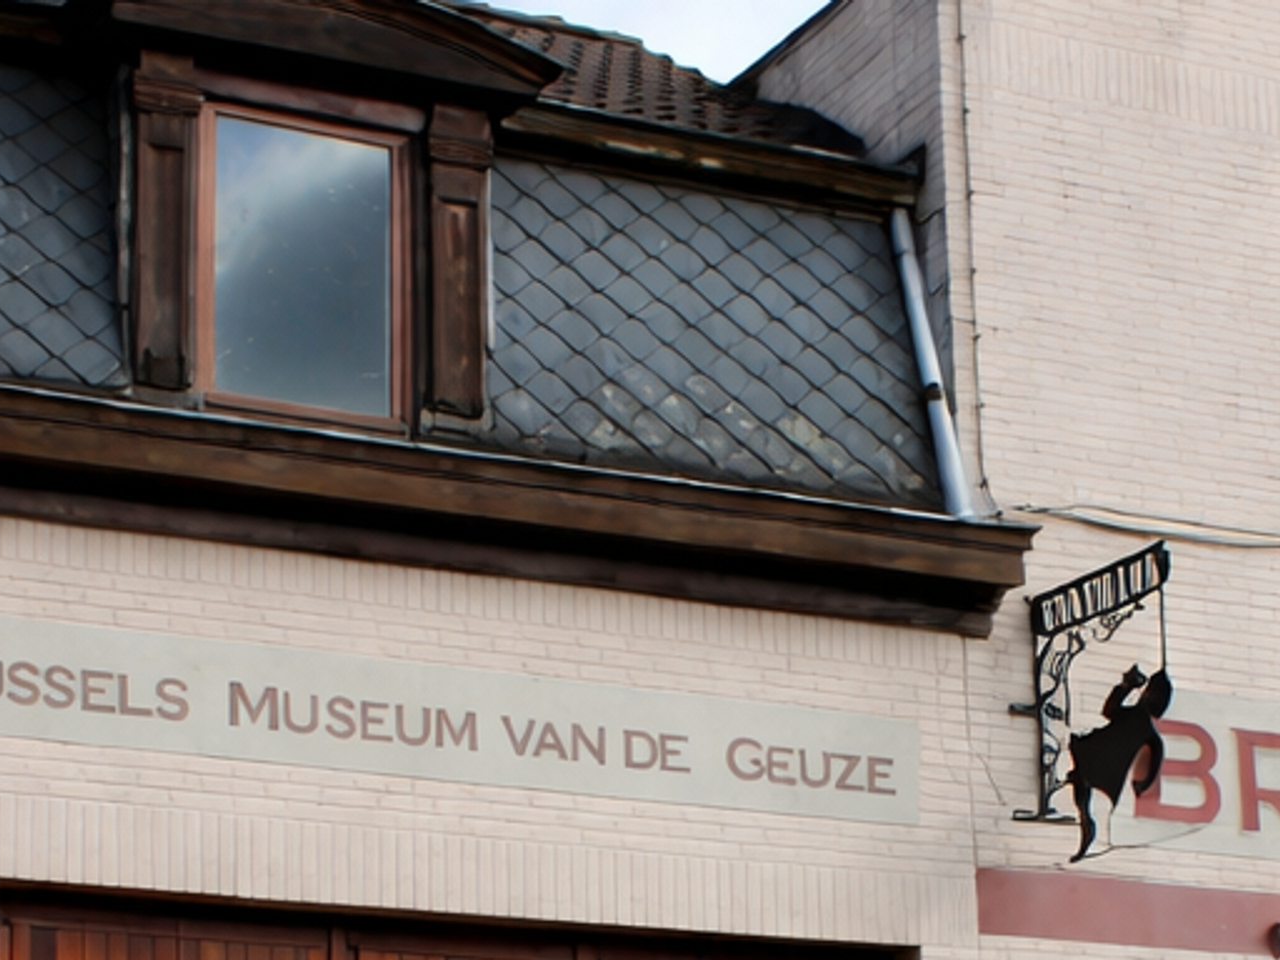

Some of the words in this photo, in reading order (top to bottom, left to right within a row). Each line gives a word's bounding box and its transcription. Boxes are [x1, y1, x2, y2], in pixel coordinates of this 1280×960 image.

[228, 681, 479, 752] MUSEUM
[500, 715, 607, 766] VAN
[623, 729, 691, 774] DE
[726, 737, 897, 796] GEUZE
